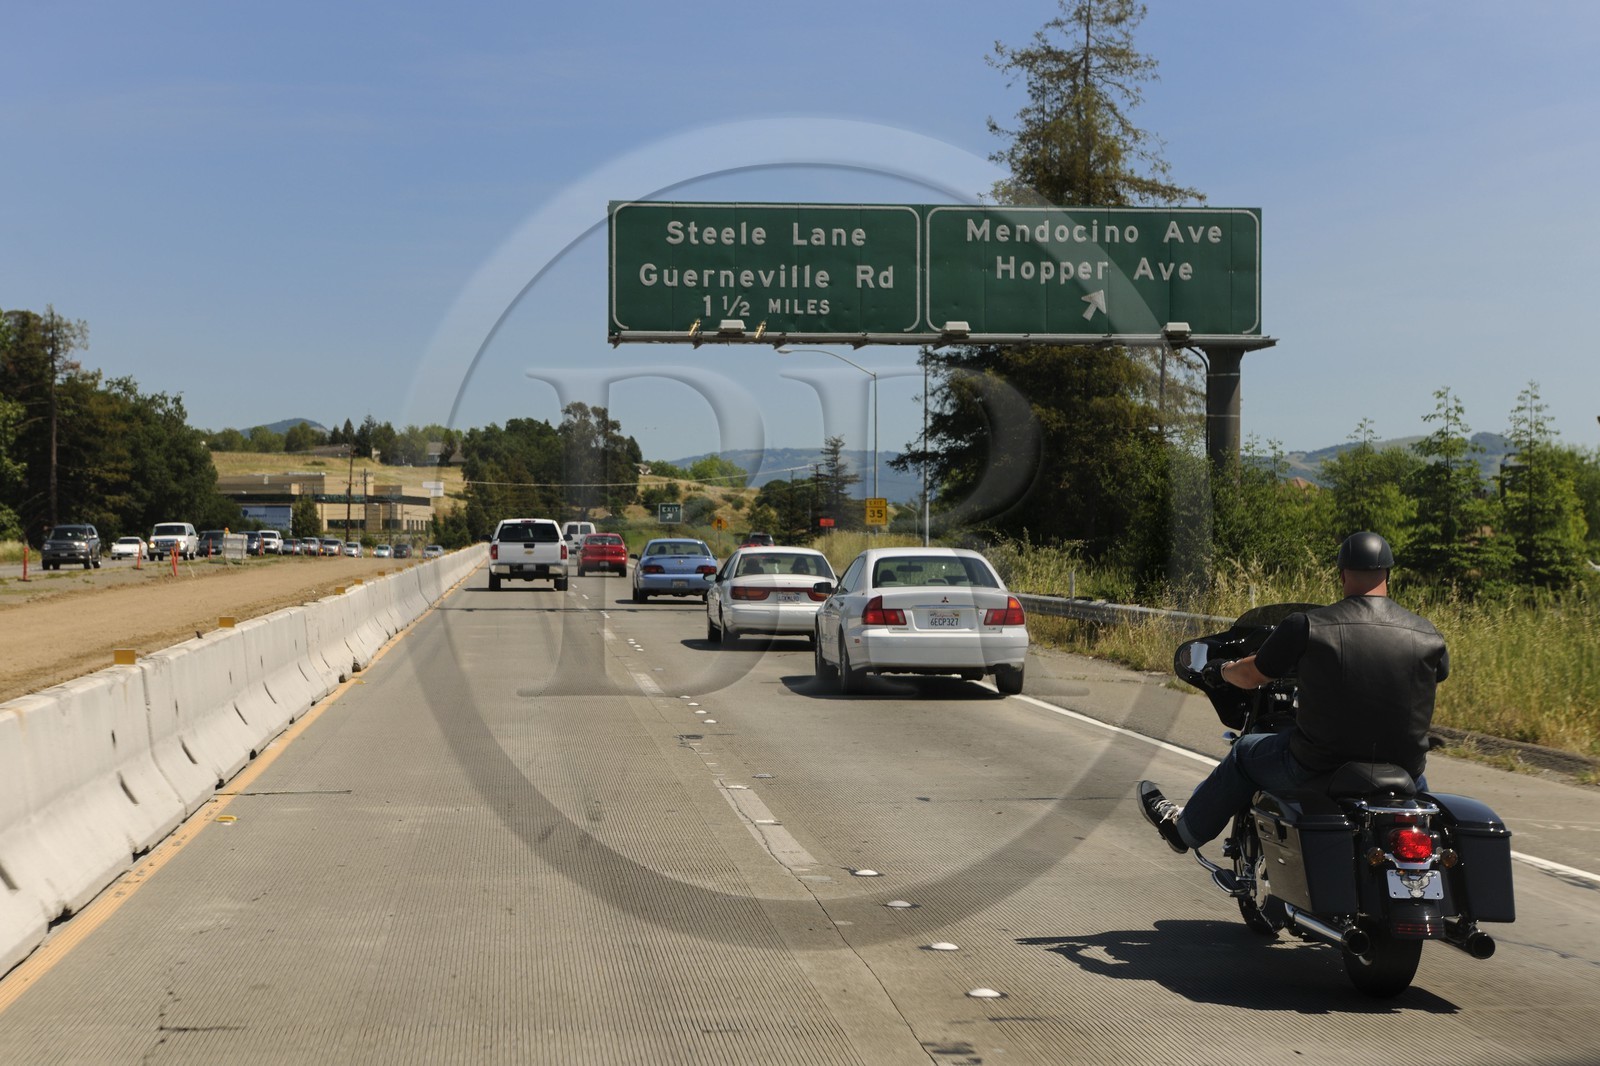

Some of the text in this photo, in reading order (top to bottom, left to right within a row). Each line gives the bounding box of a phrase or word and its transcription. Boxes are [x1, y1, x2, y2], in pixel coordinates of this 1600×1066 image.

[665, 220, 867, 246] Steele Lane
[966, 219, 1223, 244] Mendocino Ave
[639, 262, 894, 289] Guerneville Rd
[996, 255, 1193, 285] Hopper Ave
[768, 298, 831, 315] MILES
[869, 509, 883, 518] 35
[930, 618, 959, 627] 6ECP327
